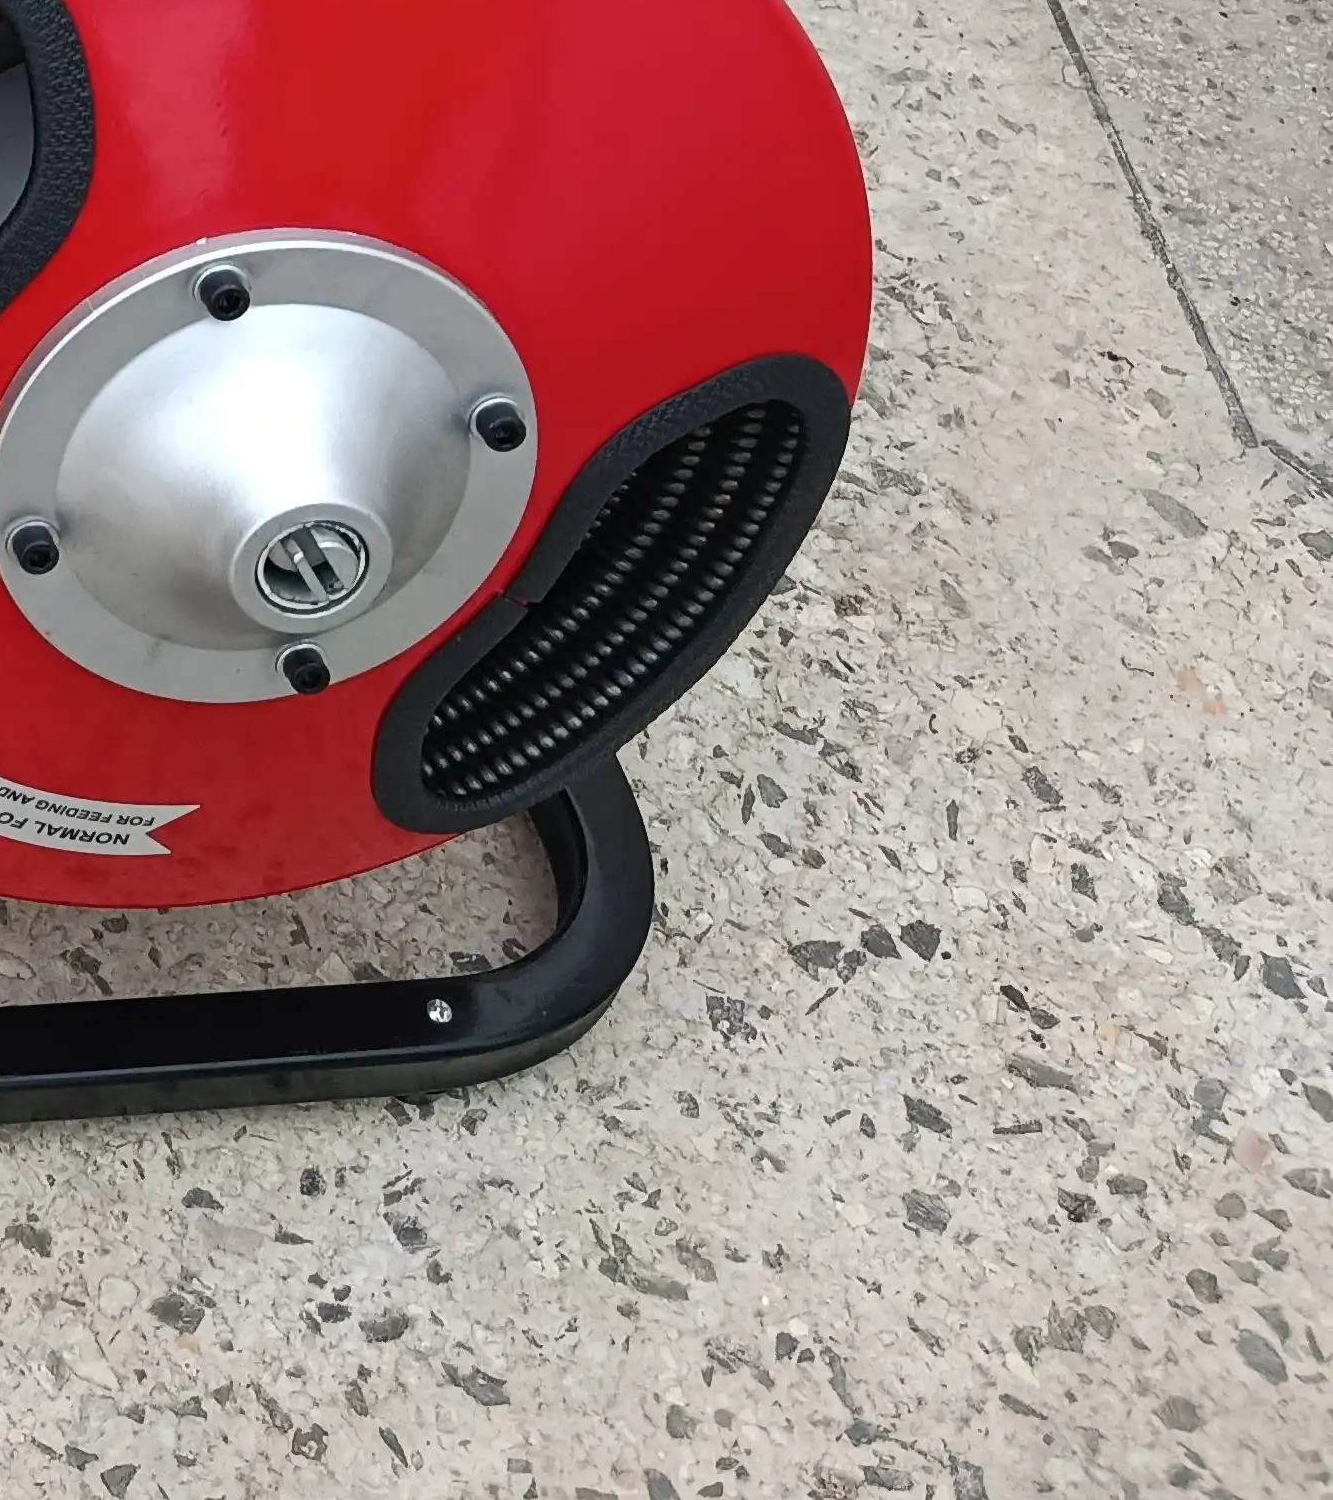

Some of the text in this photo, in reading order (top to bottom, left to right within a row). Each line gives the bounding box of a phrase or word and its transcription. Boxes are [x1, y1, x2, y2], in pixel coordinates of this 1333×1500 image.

[34, 800, 113, 824] FEEDING
[116, 812, 156, 827] FOR
[34, 820, 131, 846] NORMAL
